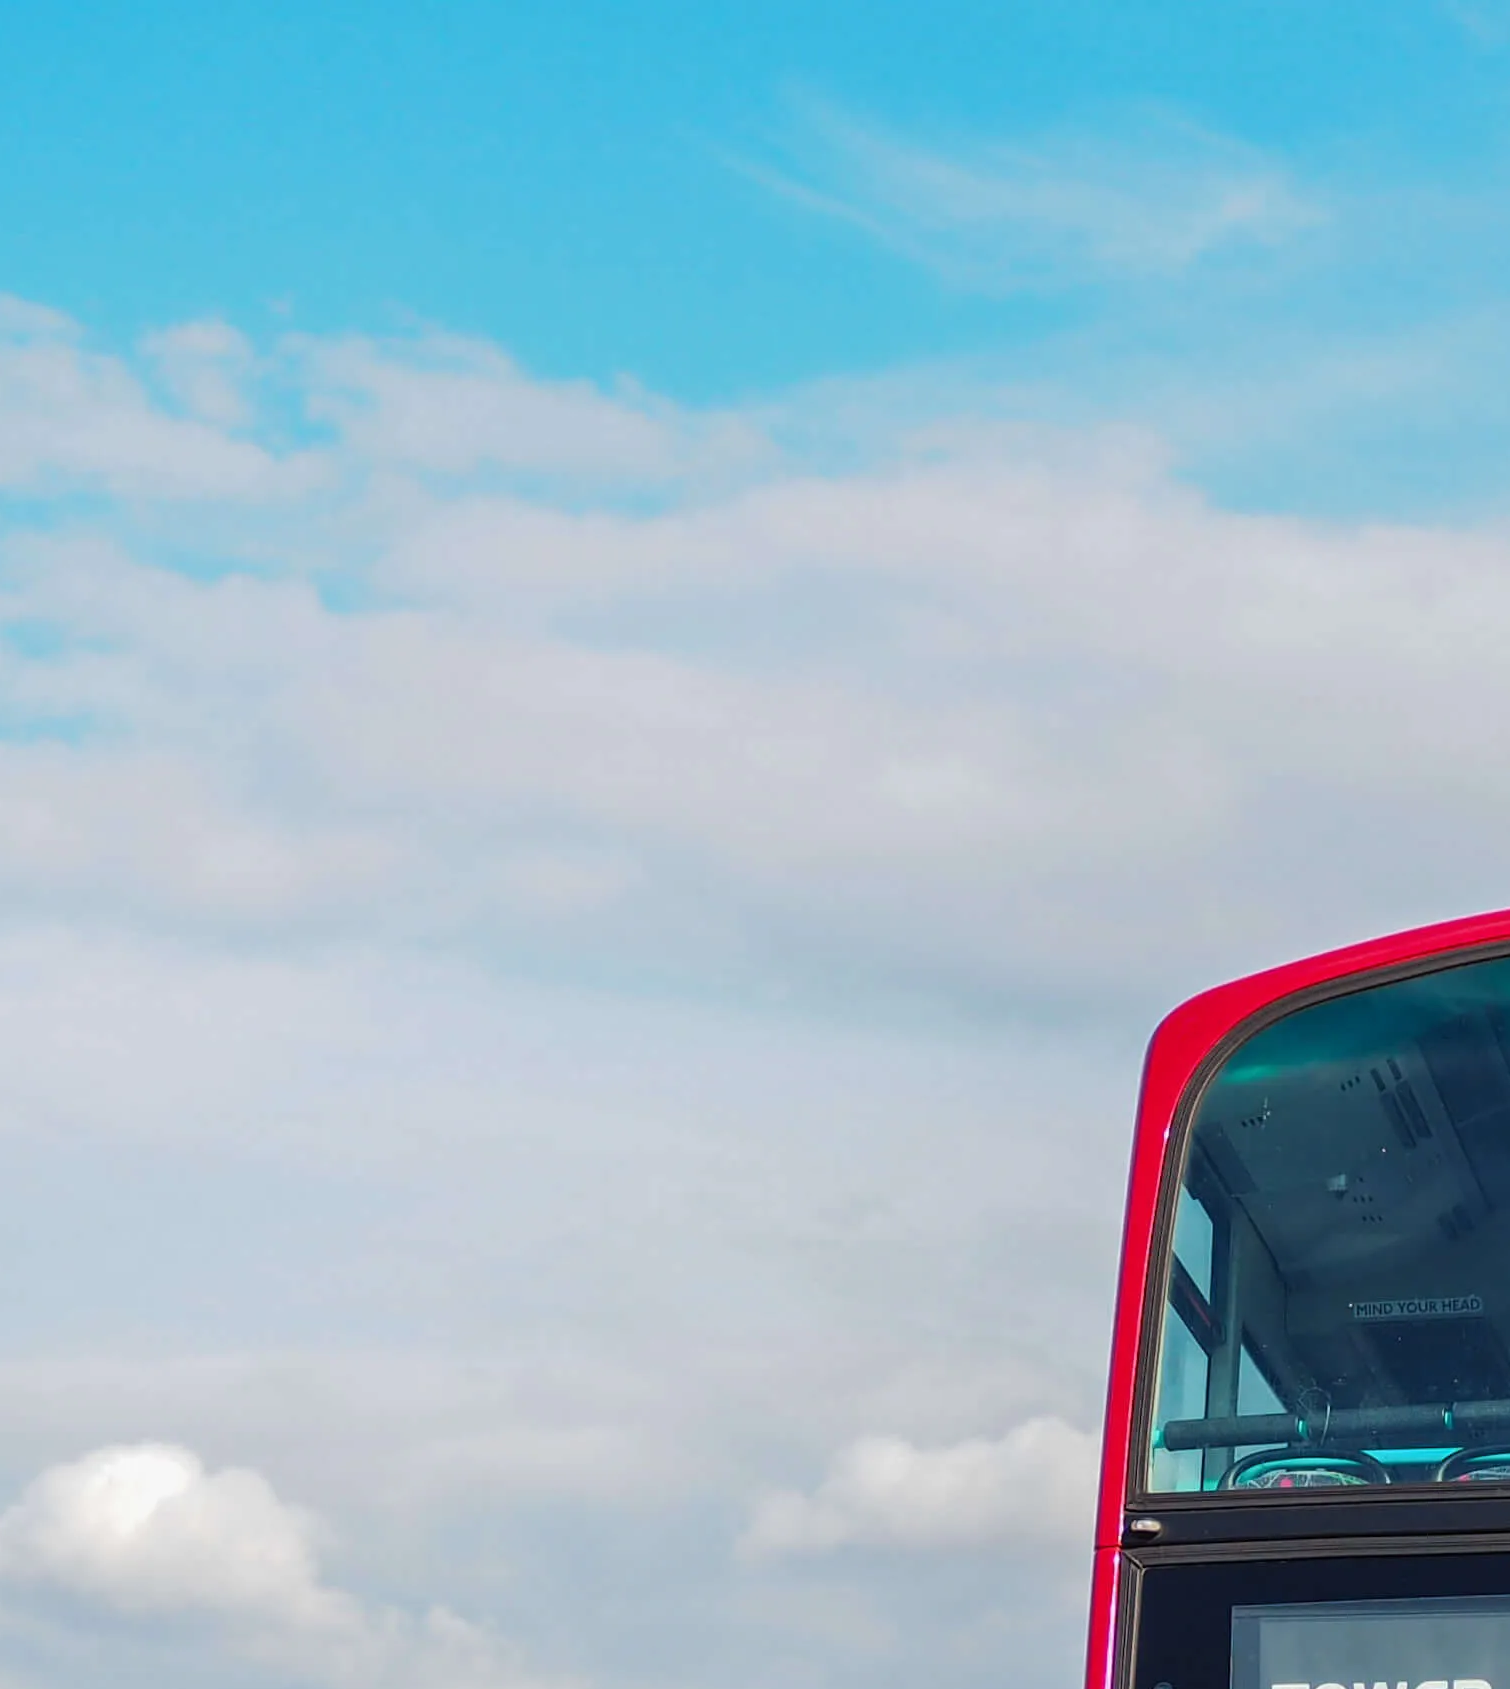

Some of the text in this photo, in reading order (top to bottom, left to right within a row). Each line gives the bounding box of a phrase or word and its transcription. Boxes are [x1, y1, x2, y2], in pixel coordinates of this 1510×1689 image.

[1356, 1298, 1480, 1316] MIND YOUR HEAD
